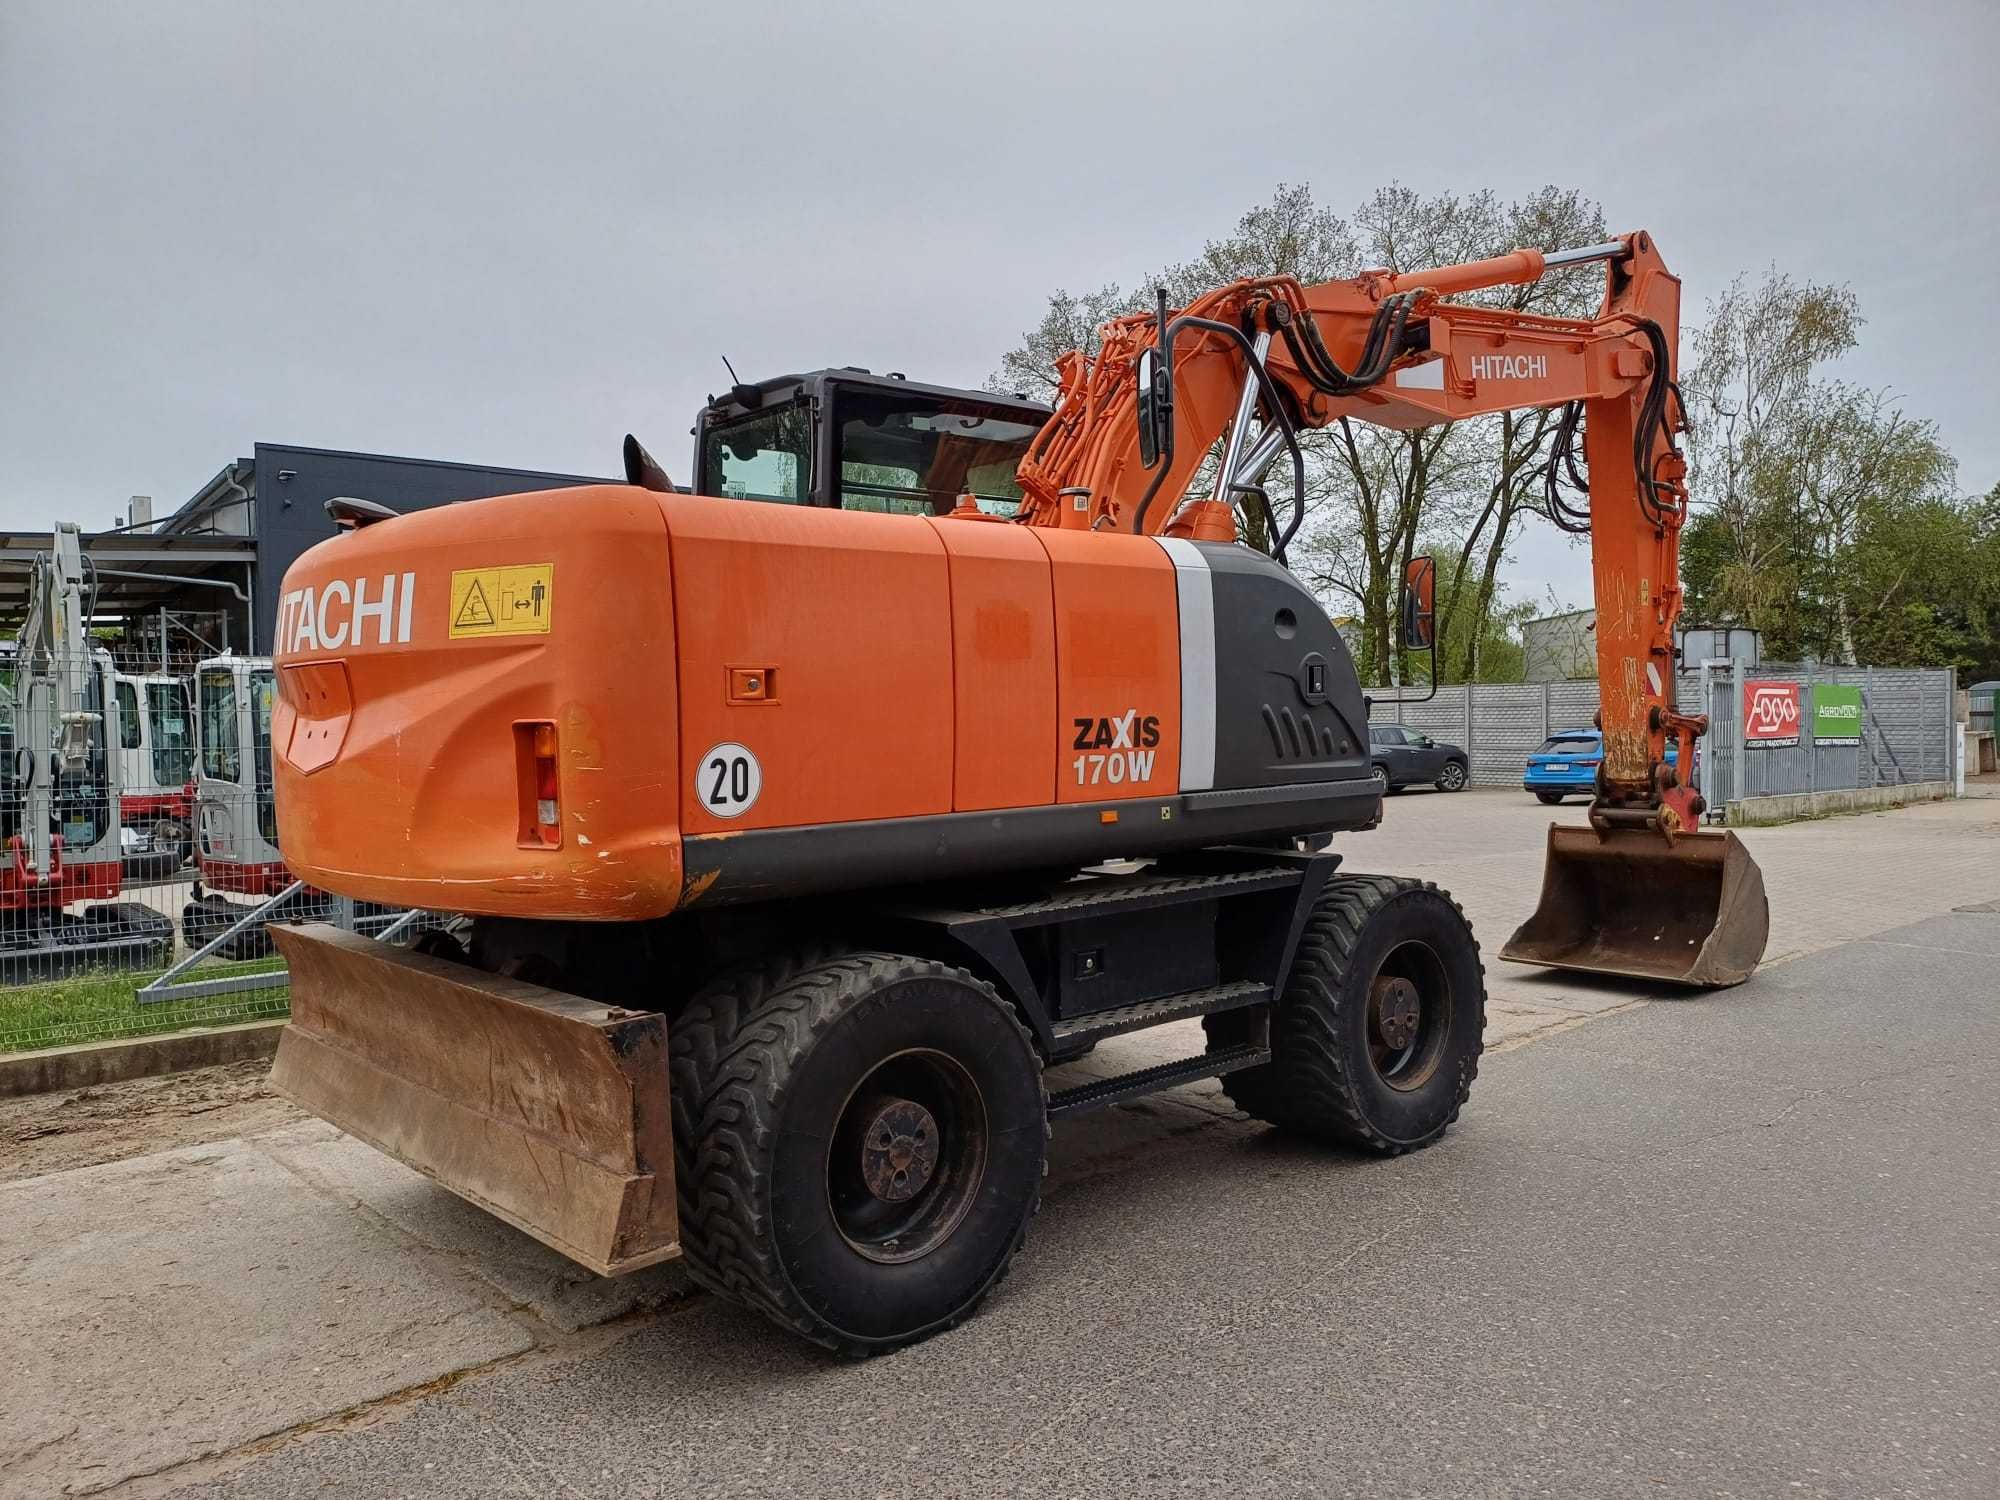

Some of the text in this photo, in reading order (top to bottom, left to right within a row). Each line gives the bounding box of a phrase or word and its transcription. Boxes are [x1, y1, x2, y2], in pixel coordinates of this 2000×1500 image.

[1471, 355, 1547, 379] HITACHI
[1073, 708, 1160, 750] ZAXIS
[710, 756, 749, 804] 20
[1073, 750, 1156, 785] 170W
